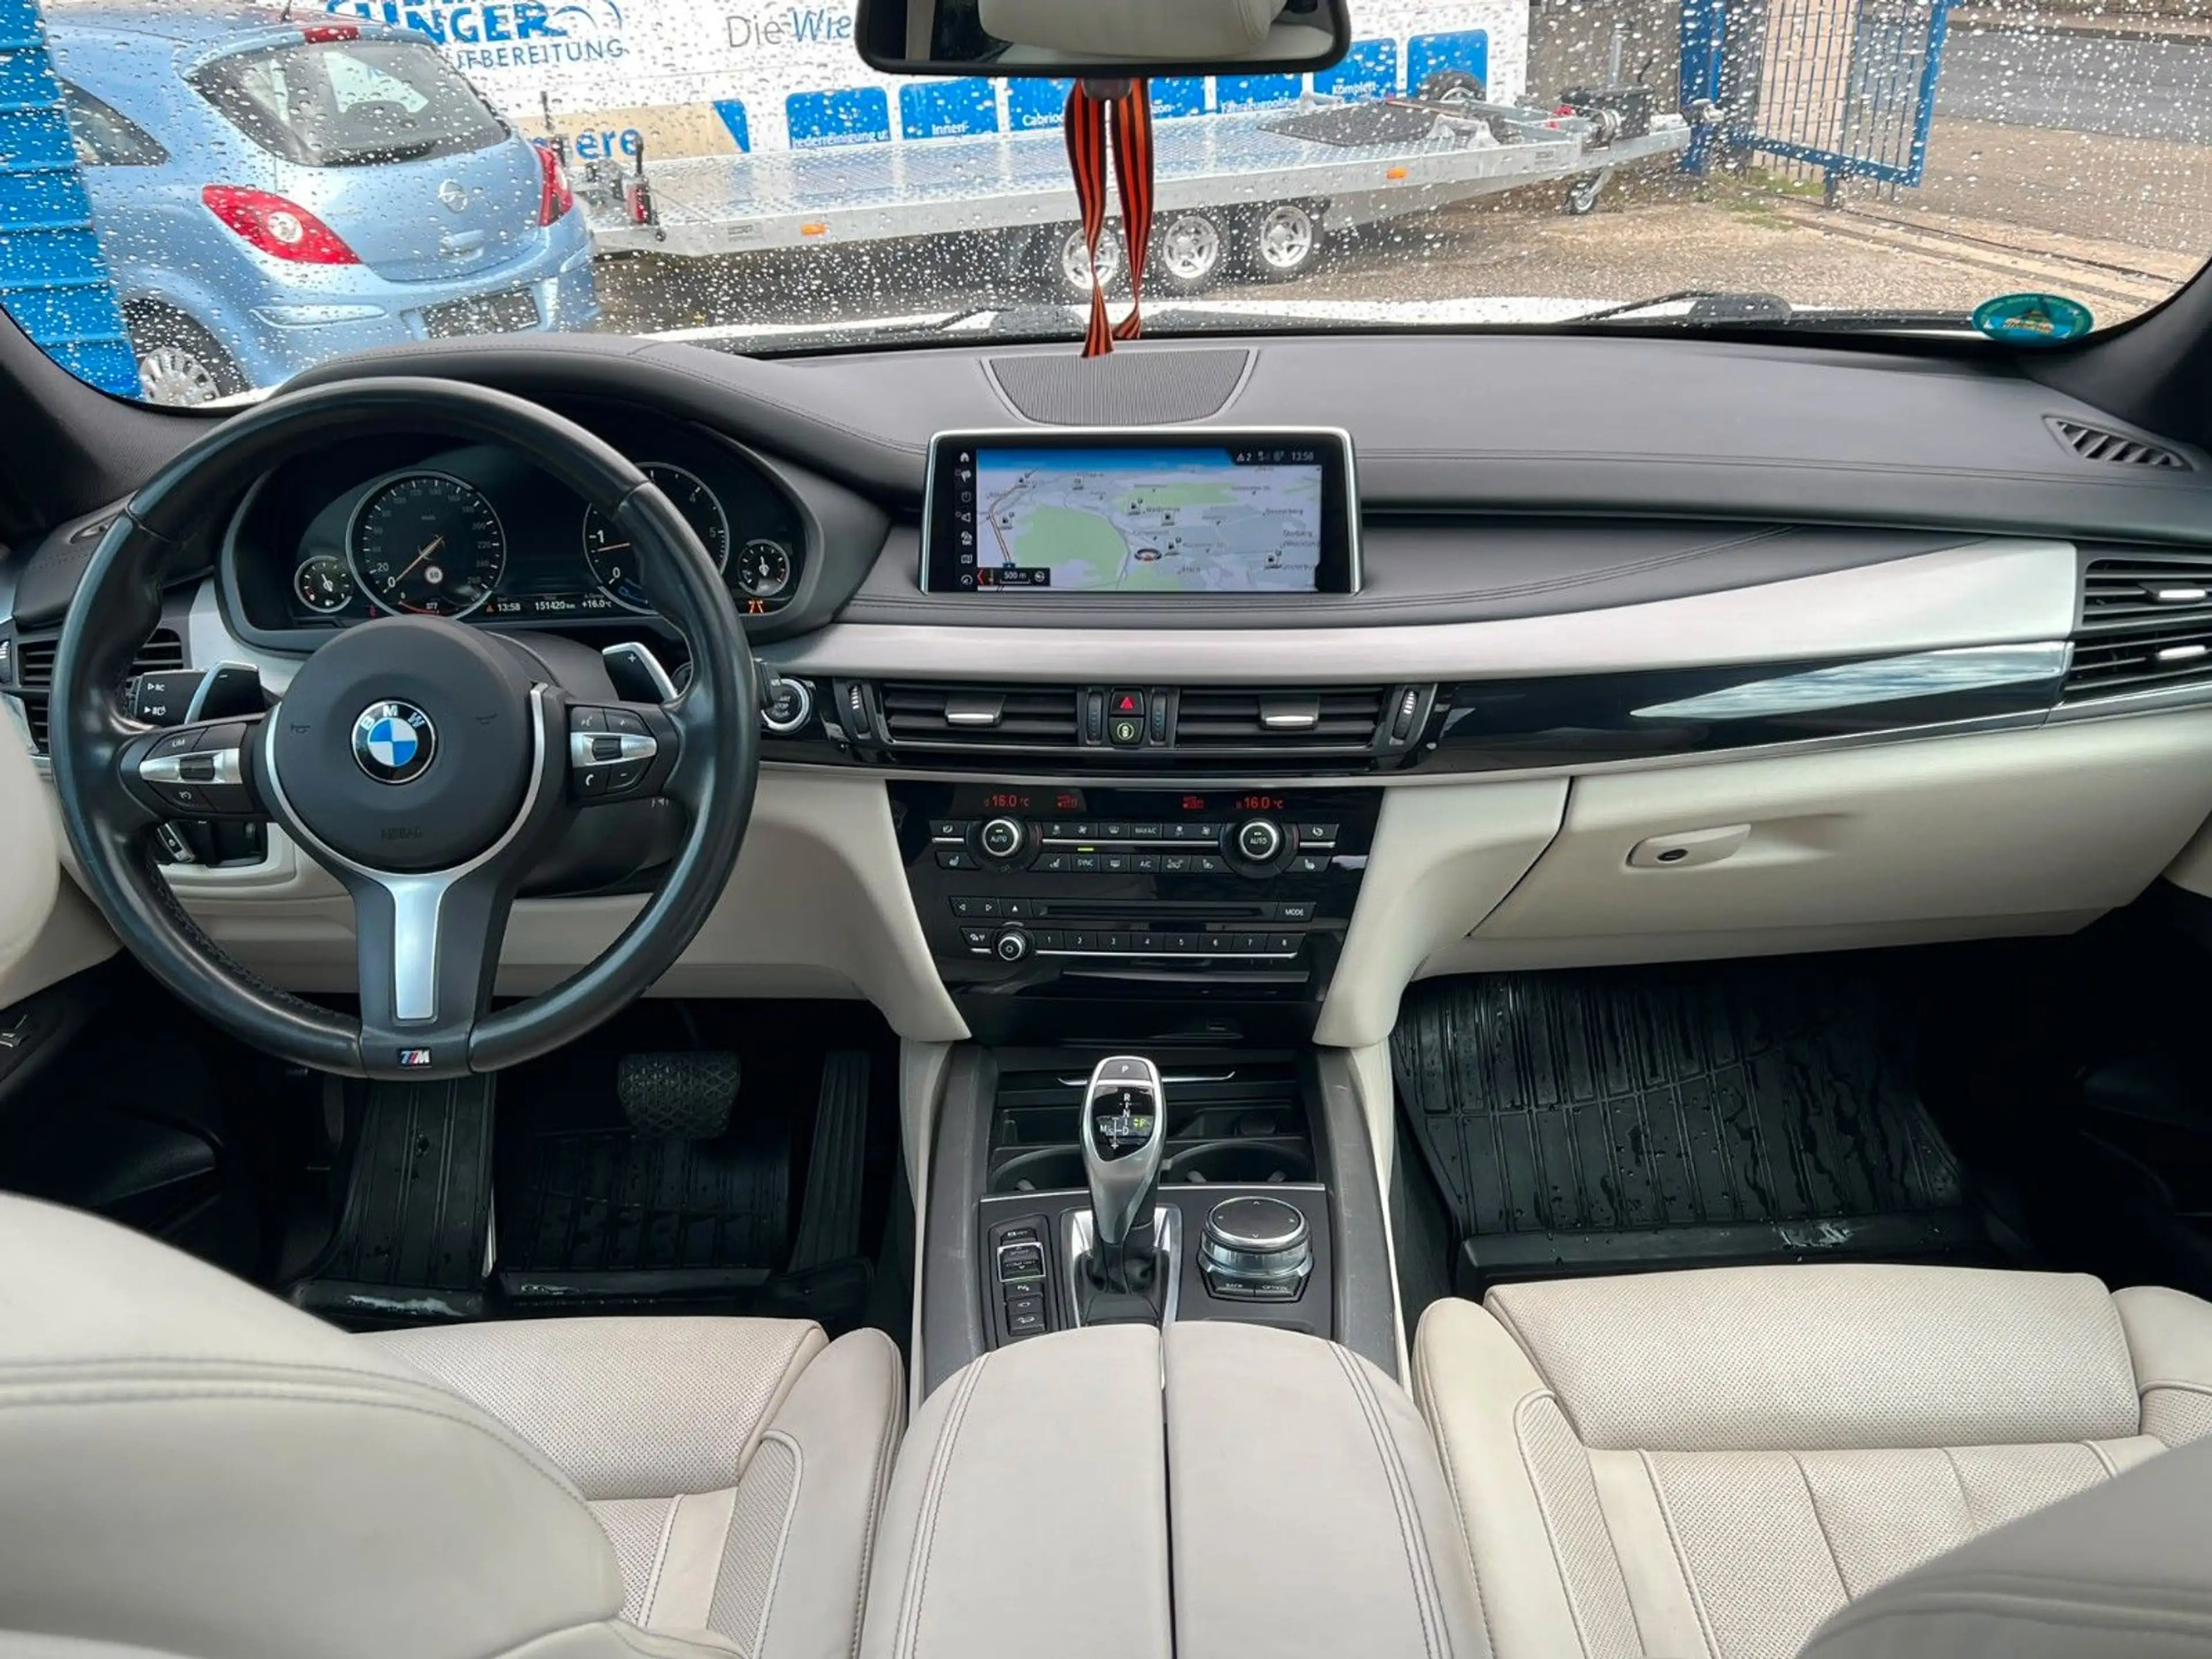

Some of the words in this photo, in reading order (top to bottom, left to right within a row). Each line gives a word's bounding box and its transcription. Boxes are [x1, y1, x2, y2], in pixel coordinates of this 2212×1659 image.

[726, 16, 785, 48] Die
[792, 9, 852, 43] Wie
[1022, 113, 1065, 126] Cabrio
[597, 530, 604, 543] 1
[377, 562, 389, 571] 20
[612, 567, 620, 579] 0
[387, 577, 396, 588] 0
[361, 704, 425, 730] BMW
[1285, 908, 1304, 916] MODE
[1124, 1093, 1131, 1101] R
[1123, 1109, 1131, 1118] N
[1123, 1126, 1129, 1135] D
